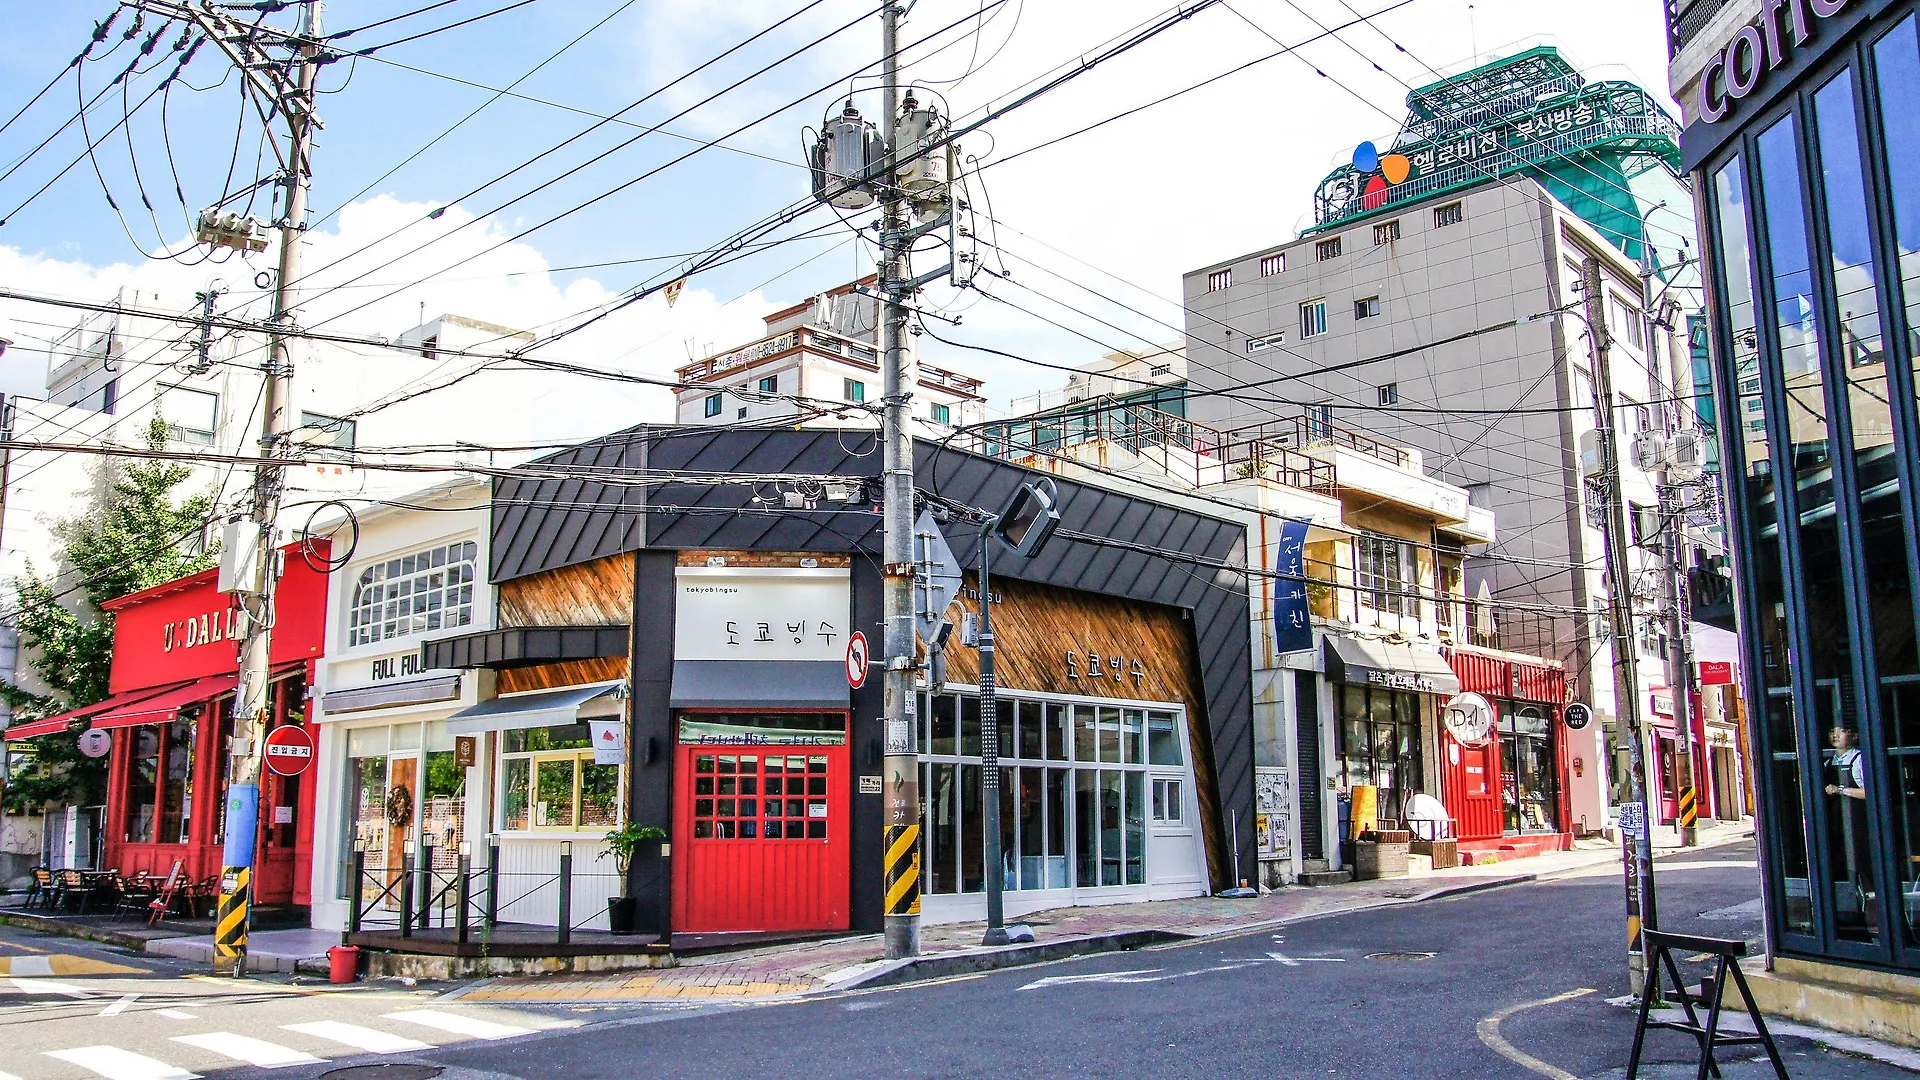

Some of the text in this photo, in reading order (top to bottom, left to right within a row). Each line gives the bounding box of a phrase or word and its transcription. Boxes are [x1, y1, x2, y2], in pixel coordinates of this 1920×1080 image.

[1697, 0, 1848, 124] cof
[1413, 103, 1595, 175] 헬로비전 부산방송
[686, 586, 738, 594] tokyobingsu
[726, 619, 838, 648] 도쿄빙수
[372, 652, 427, 681] FULL FUL
[1067, 650, 1146, 687] 도쿄빙수
[271, 745, 309, 756] 진입금지
